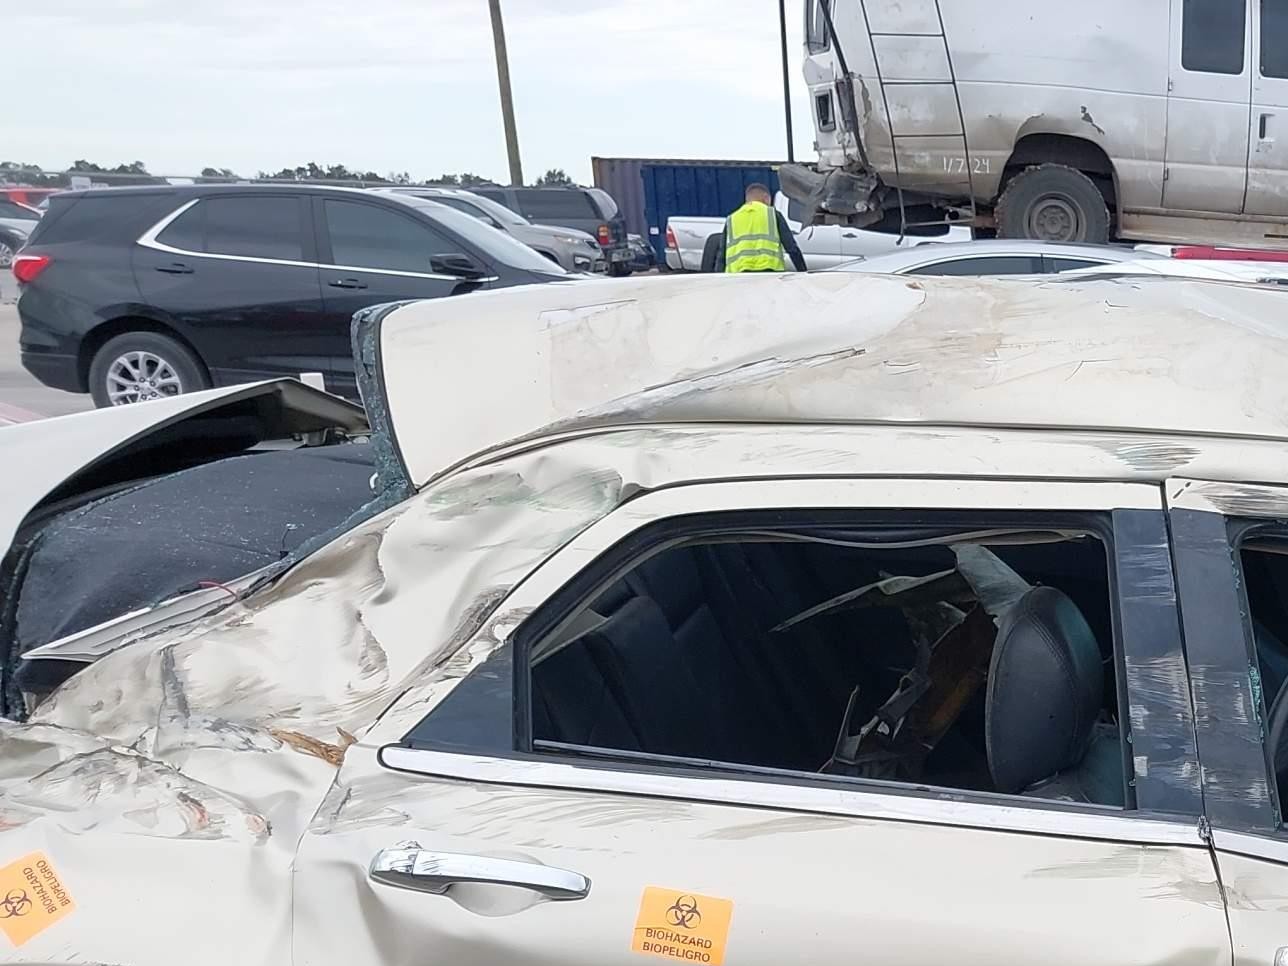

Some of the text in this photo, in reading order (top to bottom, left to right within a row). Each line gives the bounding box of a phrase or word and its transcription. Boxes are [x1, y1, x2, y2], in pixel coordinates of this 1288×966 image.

[22, 867, 57, 914] BIOHAZARD
[36, 860, 71, 907] BIOPELIGRO
[642, 941, 711, 963] BIOPELIGRO
[645, 928, 713, 949] BIOHAZARD
